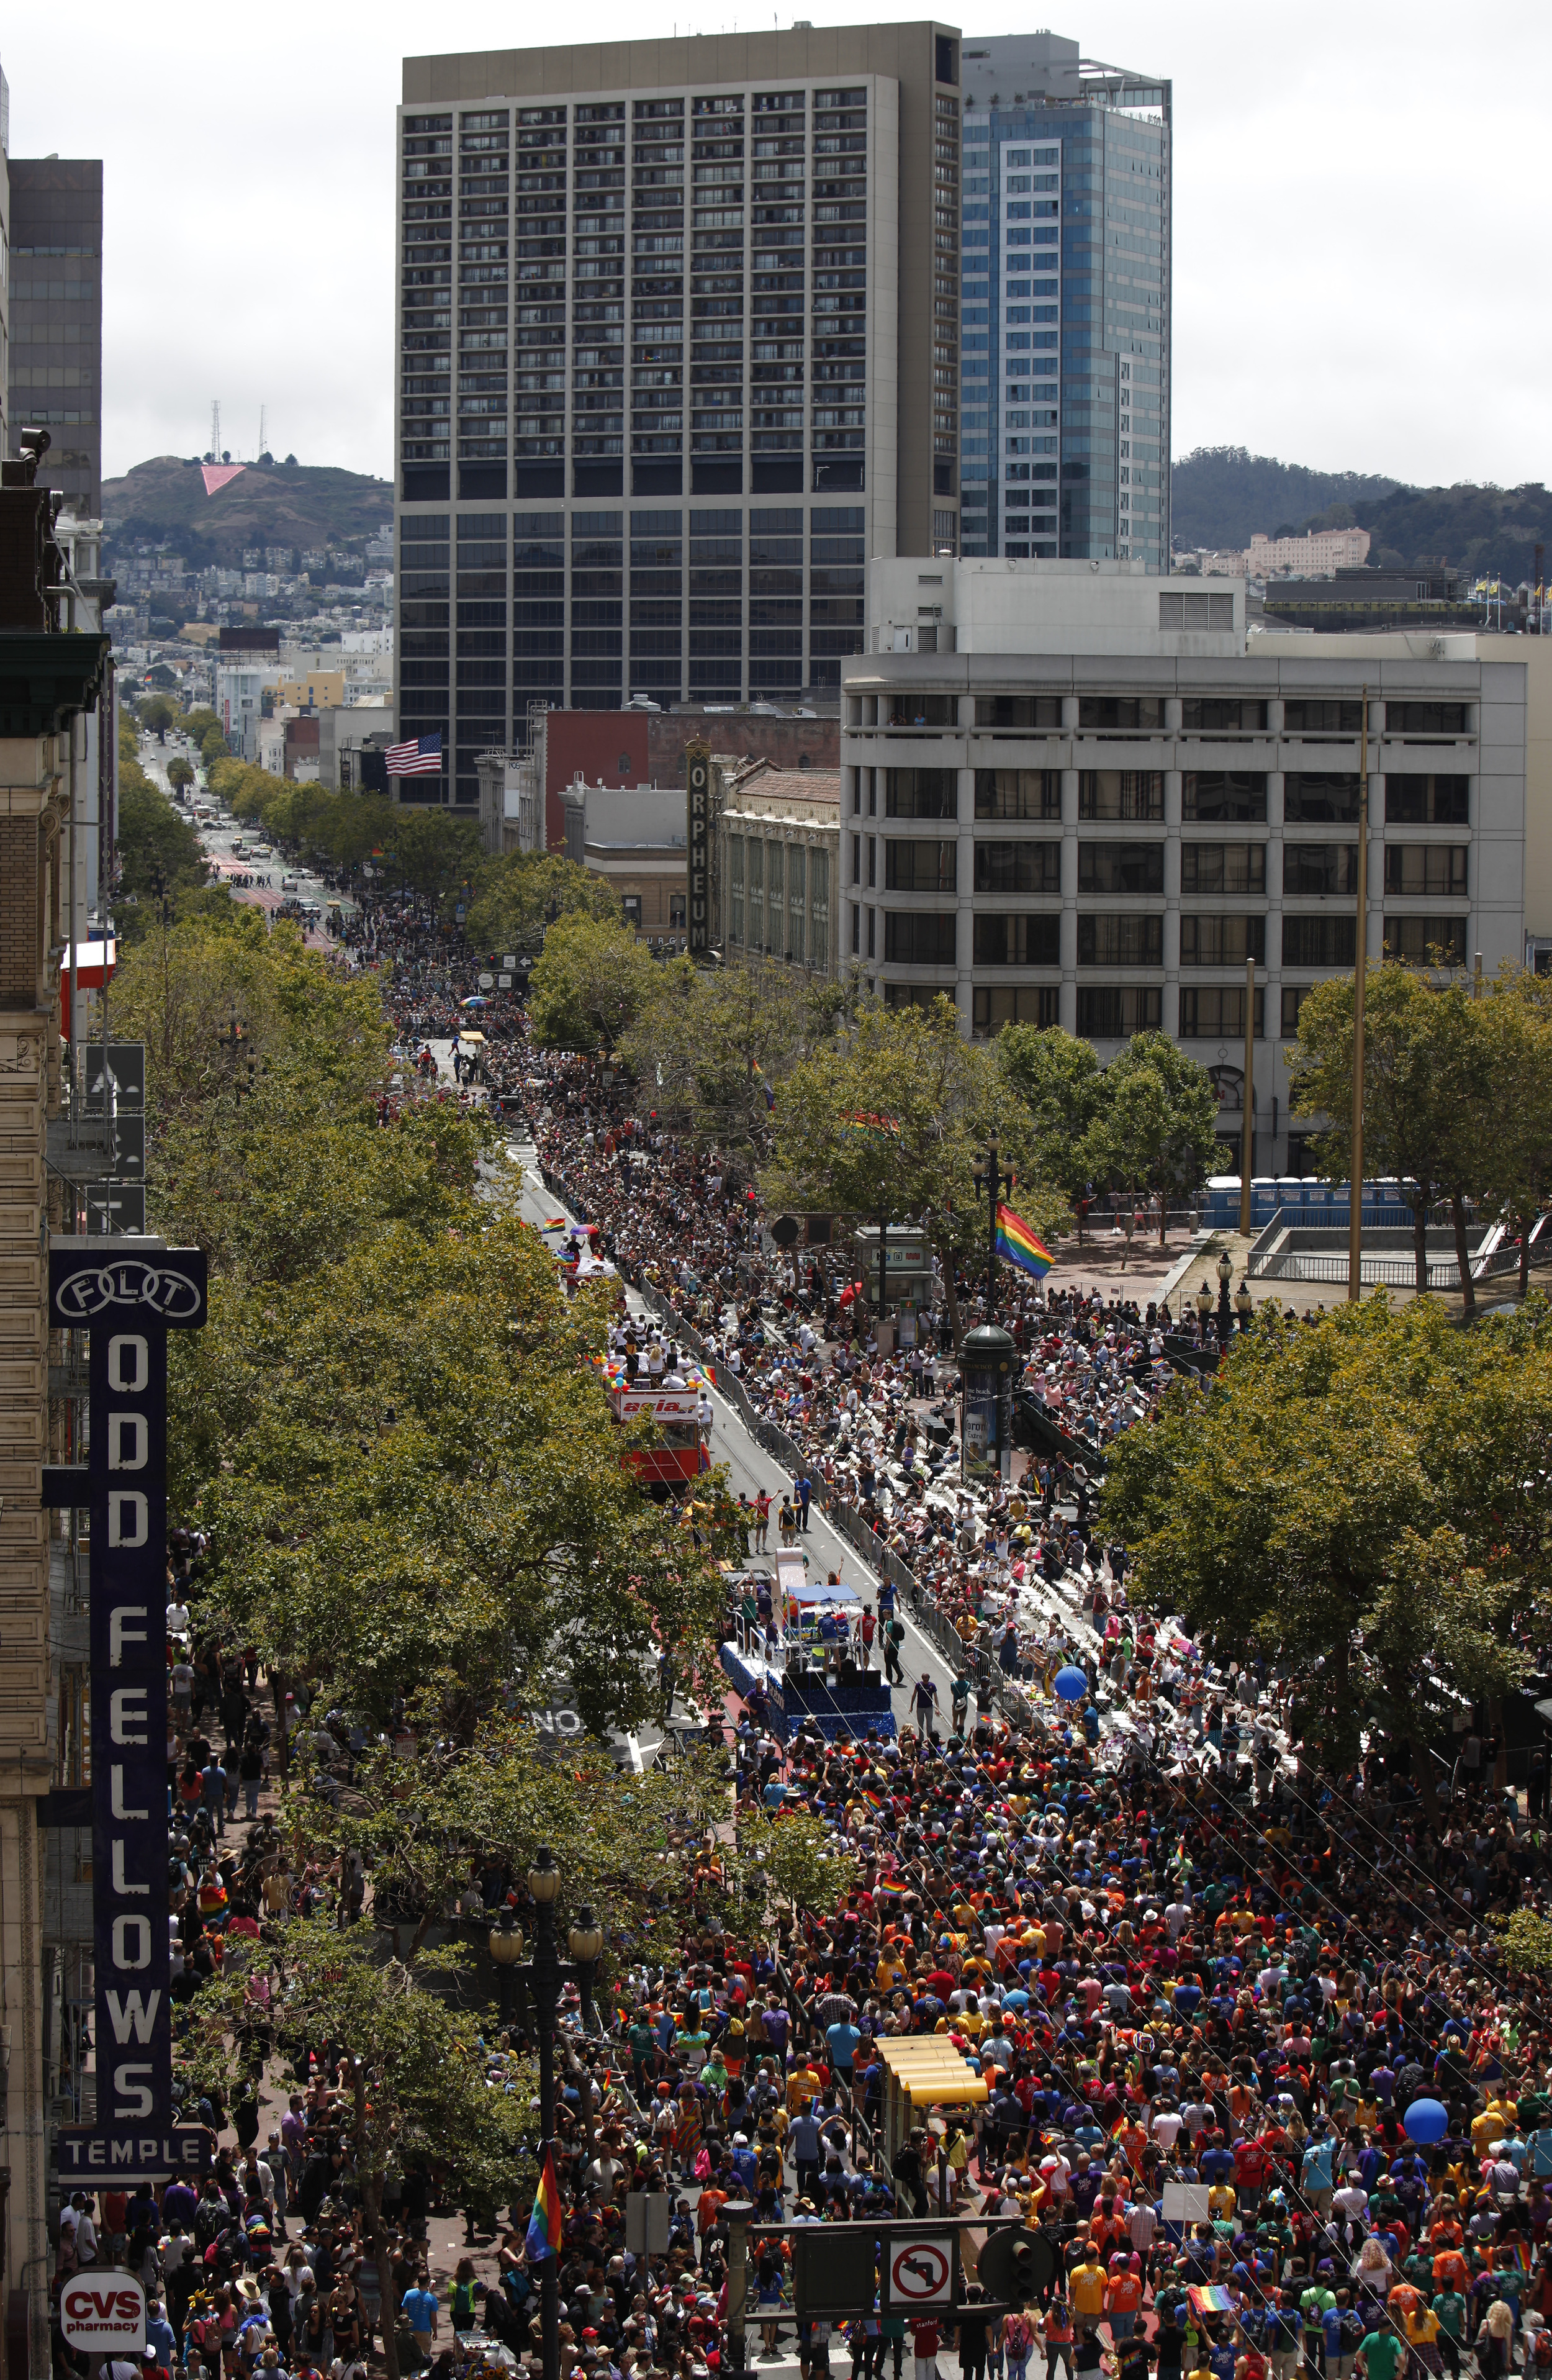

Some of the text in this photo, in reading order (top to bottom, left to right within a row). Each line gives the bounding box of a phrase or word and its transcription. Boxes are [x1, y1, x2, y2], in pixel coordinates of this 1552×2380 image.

[692, 766, 705, 948] ORPHEUM
[108, 1334, 148, 1547] ODD
[968, 1431, 982, 1439] Extra
[531, 1709, 580, 1733] NO
[106, 1606, 160, 2118] FELLOWS
[66, 2140, 199, 2163] TEMPLE
[65, 2291, 141, 2319] CVS
[66, 2322, 139, 2335] pharmacy
[916, 2319, 937, 2328] stanford
